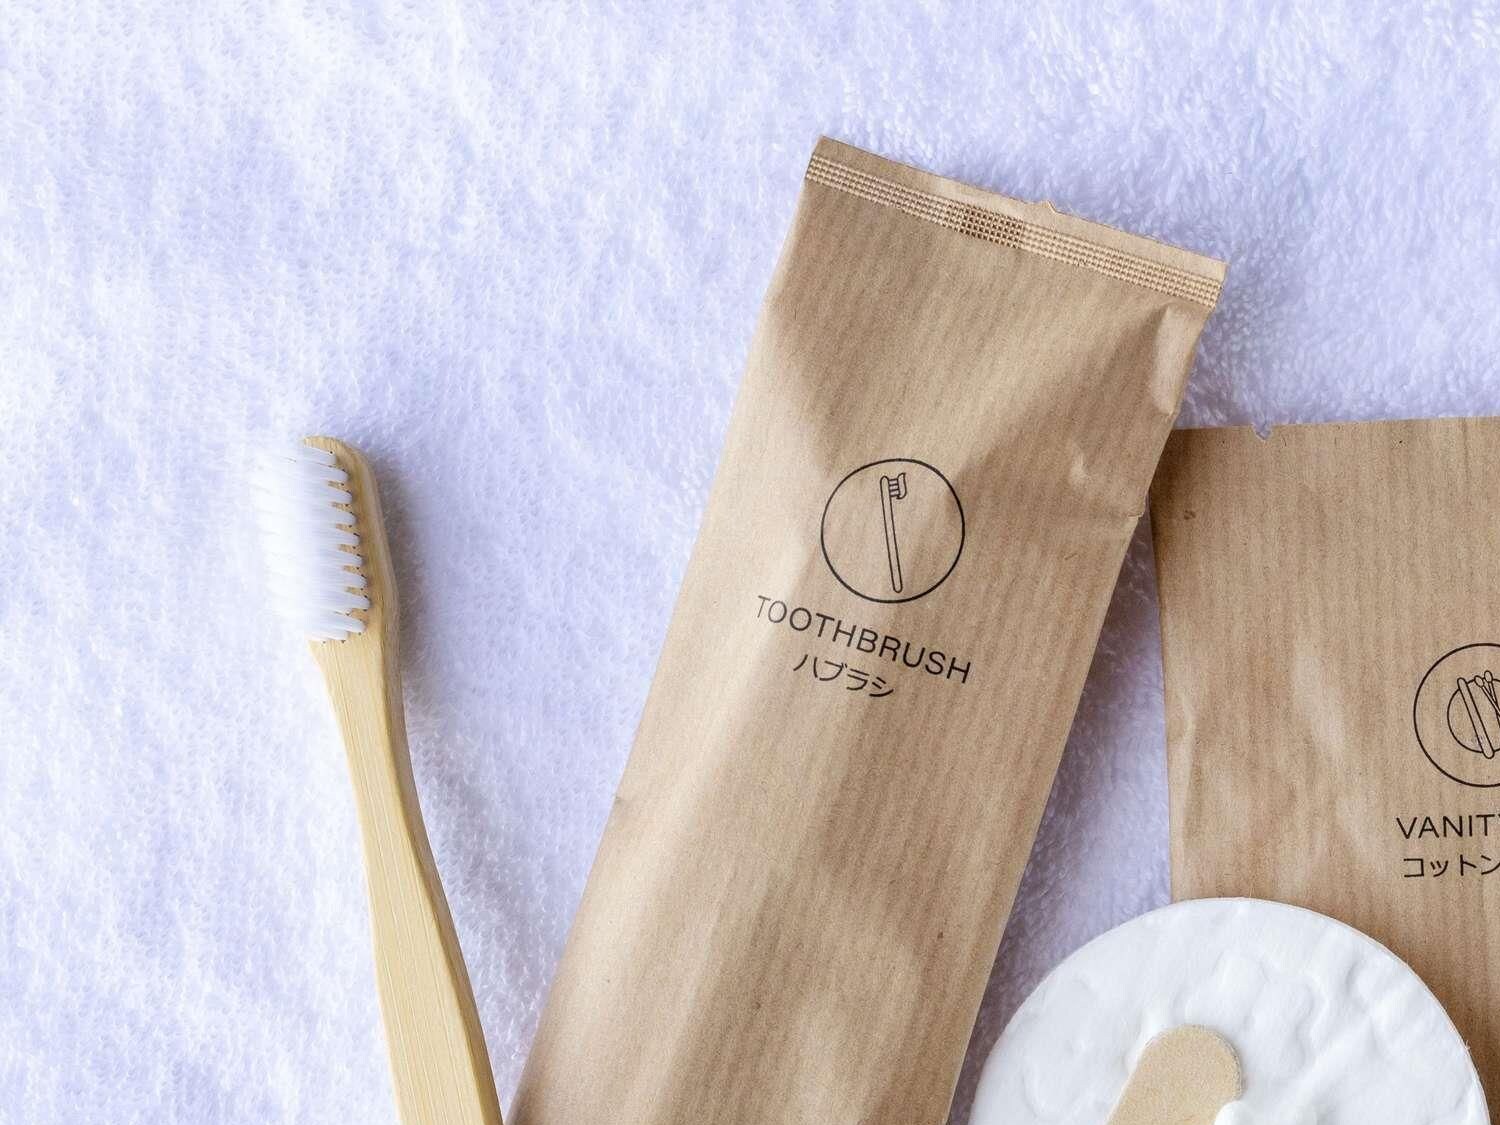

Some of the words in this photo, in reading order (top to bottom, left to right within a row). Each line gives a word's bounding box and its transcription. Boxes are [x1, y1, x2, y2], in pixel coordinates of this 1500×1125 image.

[757, 594, 971, 684] TOOTHBRUSH
[793, 654, 894, 698] ハブラシ
